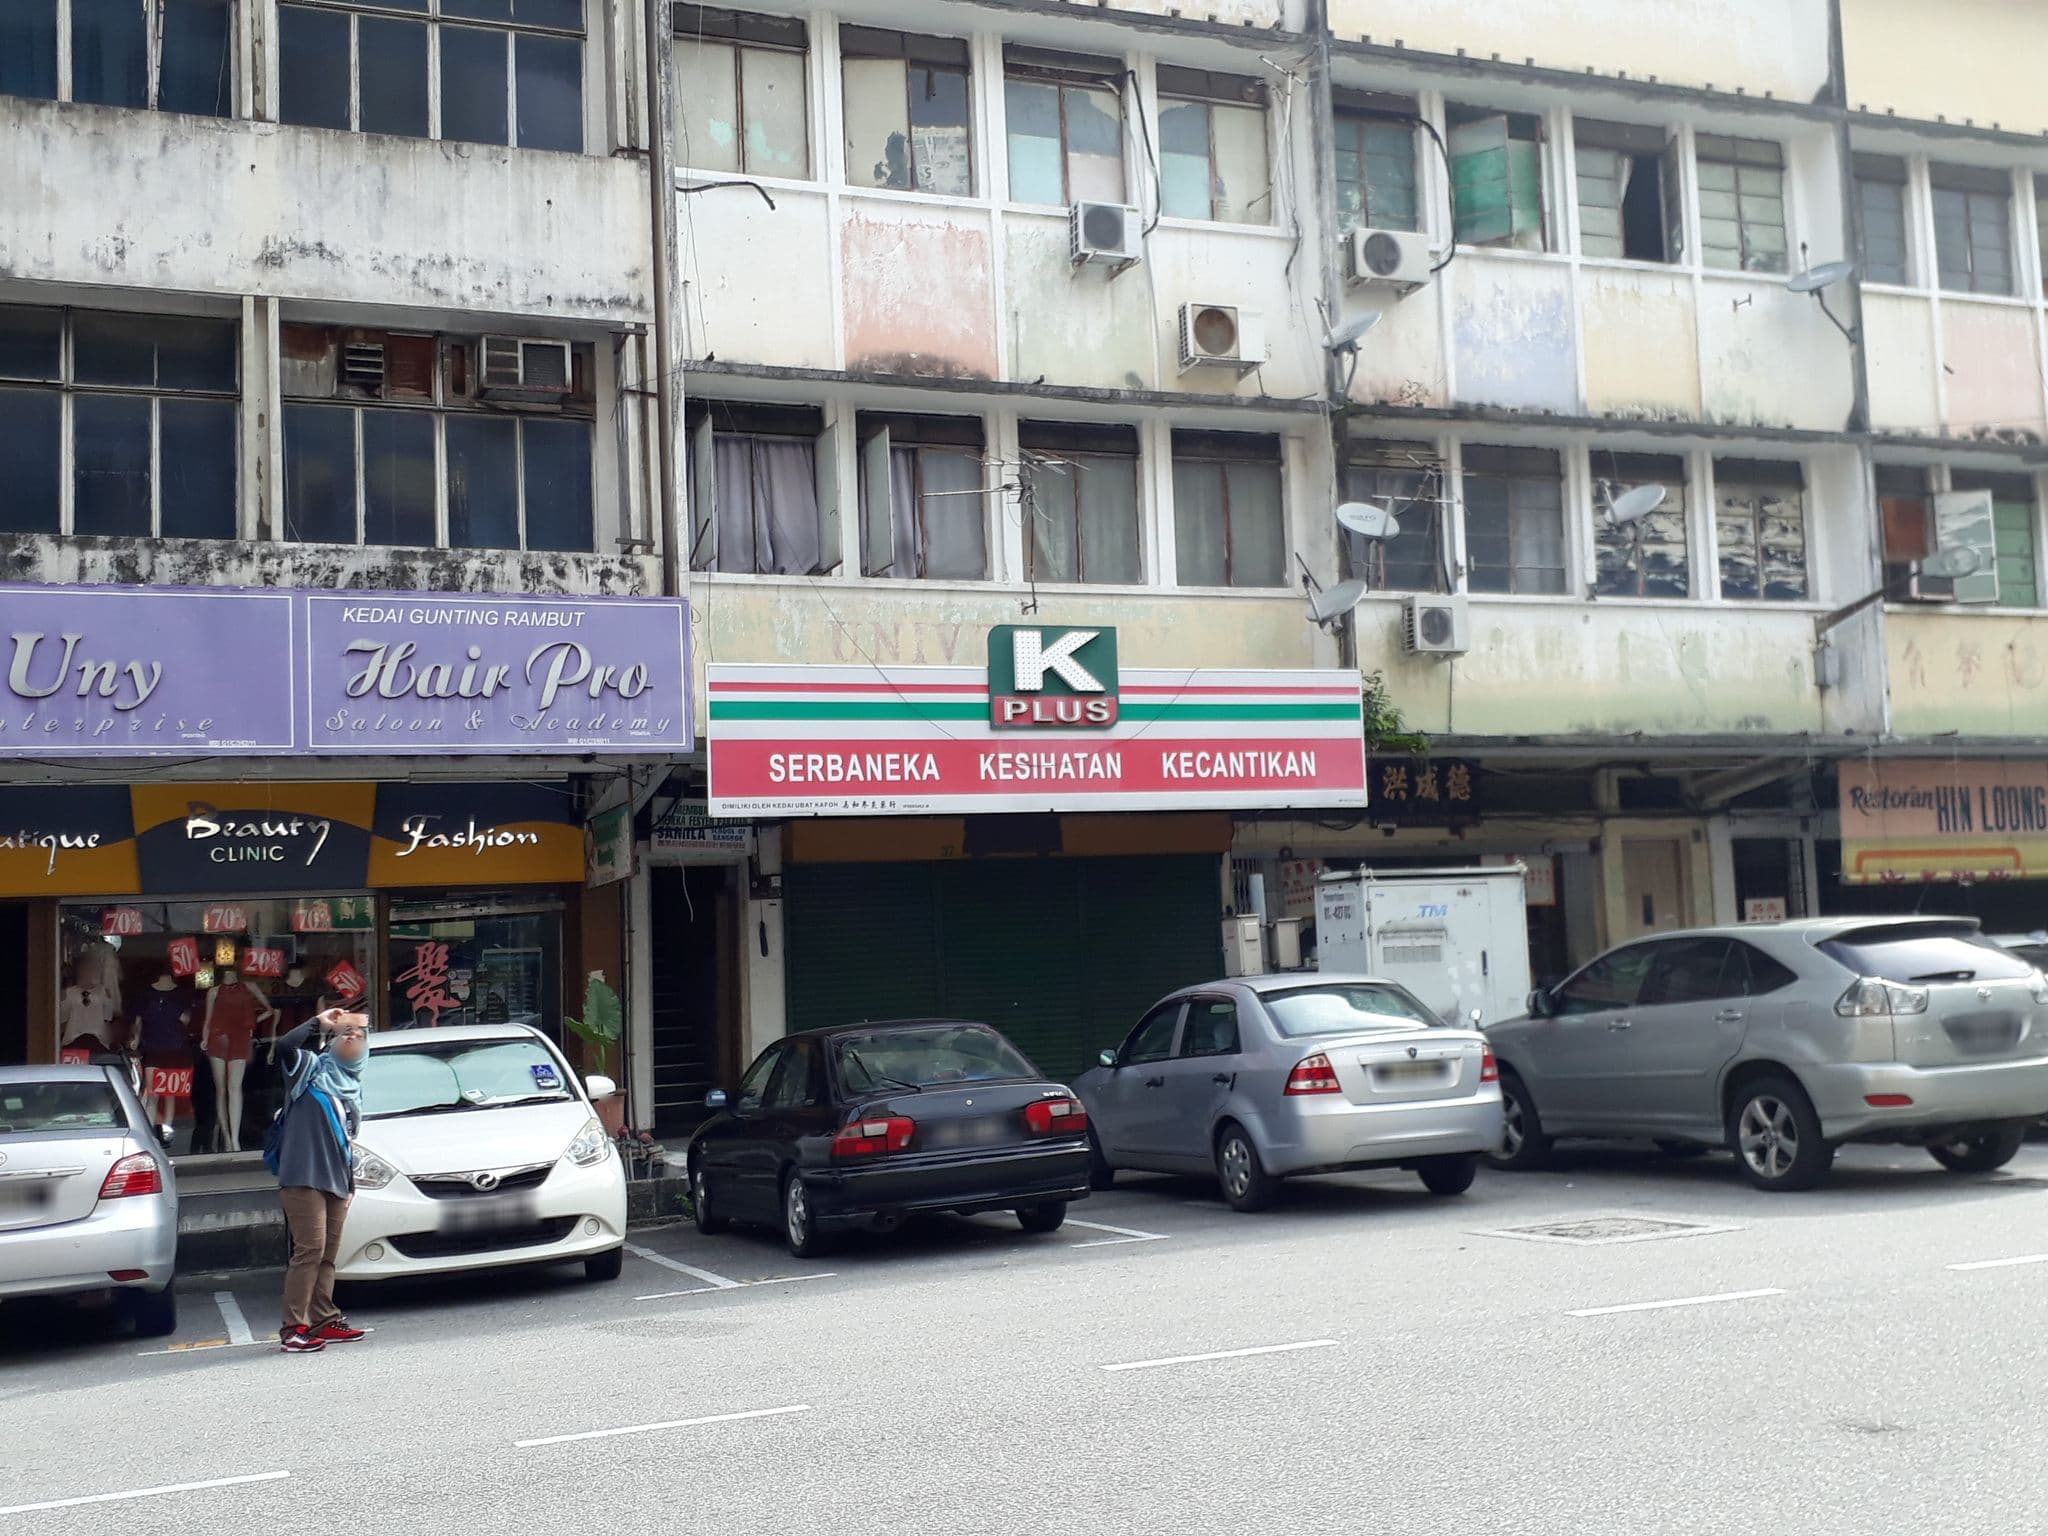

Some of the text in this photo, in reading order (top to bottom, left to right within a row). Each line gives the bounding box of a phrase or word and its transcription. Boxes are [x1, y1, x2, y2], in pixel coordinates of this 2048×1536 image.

[343, 607, 586, 627] KEDAI GUNTING RAMBUT
[8, 632, 163, 711] Uny
[1013, 630, 1106, 692] K
[342, 638, 655, 711] Hair Pro
[324, 708, 671, 737] Saloon & Academy
[1003, 698, 1111, 723] PLUS
[768, 750, 1317, 783] SERBANEKA KESIHATAN KECANTIKAN
[1935, 785, 1973, 832] HIN
[1979, 785, 2047, 832] LOONG
[186, 801, 331, 866] Beauty
[394, 813, 539, 857] Fashion
[209, 846, 286, 863] CLINIC
[105, 911, 143, 934] 70%
[210, 905, 247, 930] 70%
[296, 909, 332, 930] 70%
[1416, 904, 1448, 918] TM
[244, 950, 281, 974] 20%
[154, 1071, 192, 1095] 20%
